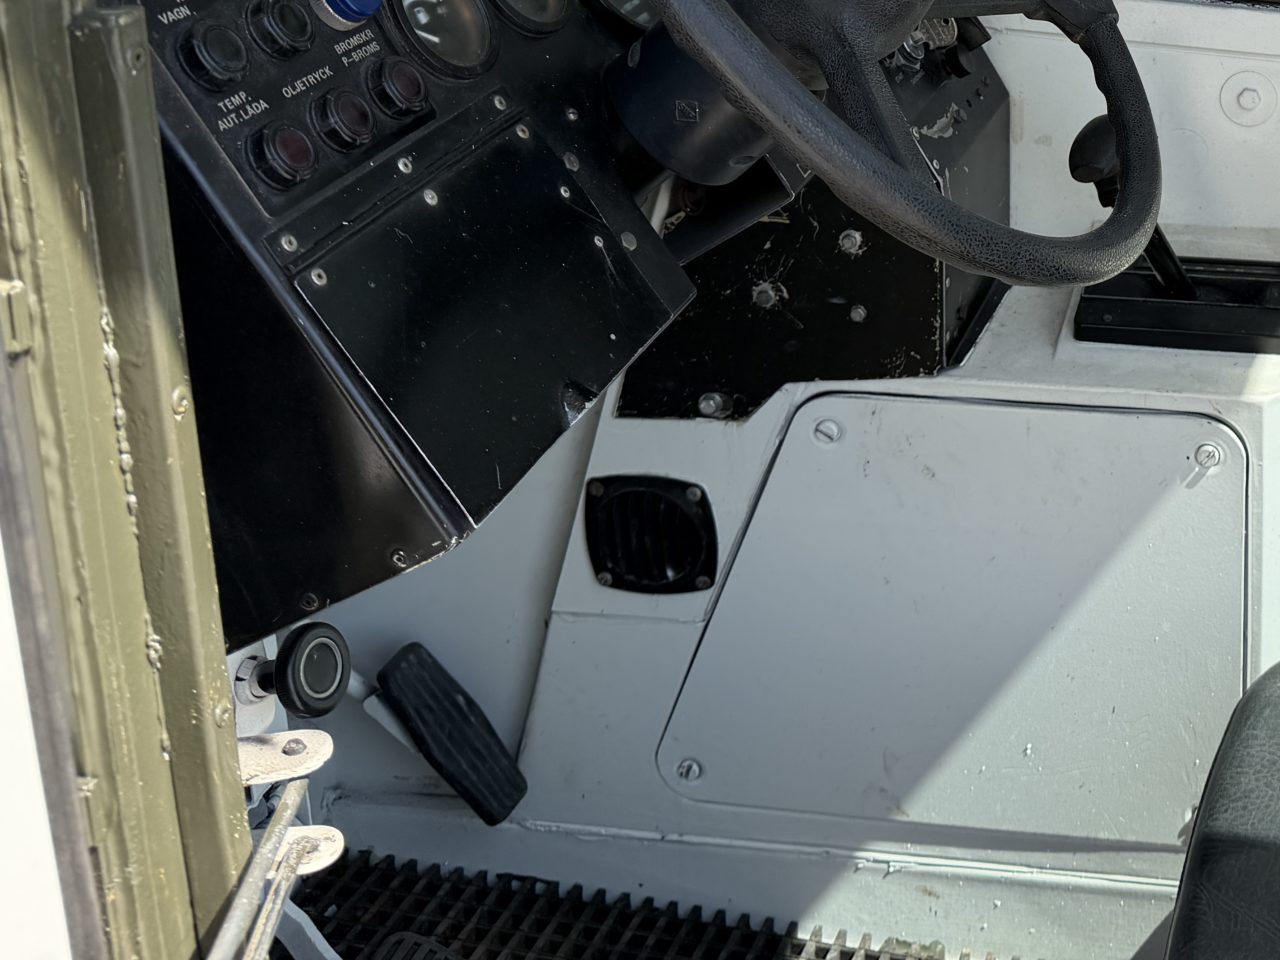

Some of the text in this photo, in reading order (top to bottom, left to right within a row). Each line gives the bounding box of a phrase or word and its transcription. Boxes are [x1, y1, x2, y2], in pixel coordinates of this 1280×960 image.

[158, 6, 192, 25] VAGN
[334, 29, 374, 54] BROMSKR
[341, 42, 381, 67] P-BROMS
[282, 66, 333, 98] OLJETRYCK
[217, 92, 252, 113] TEMP.
